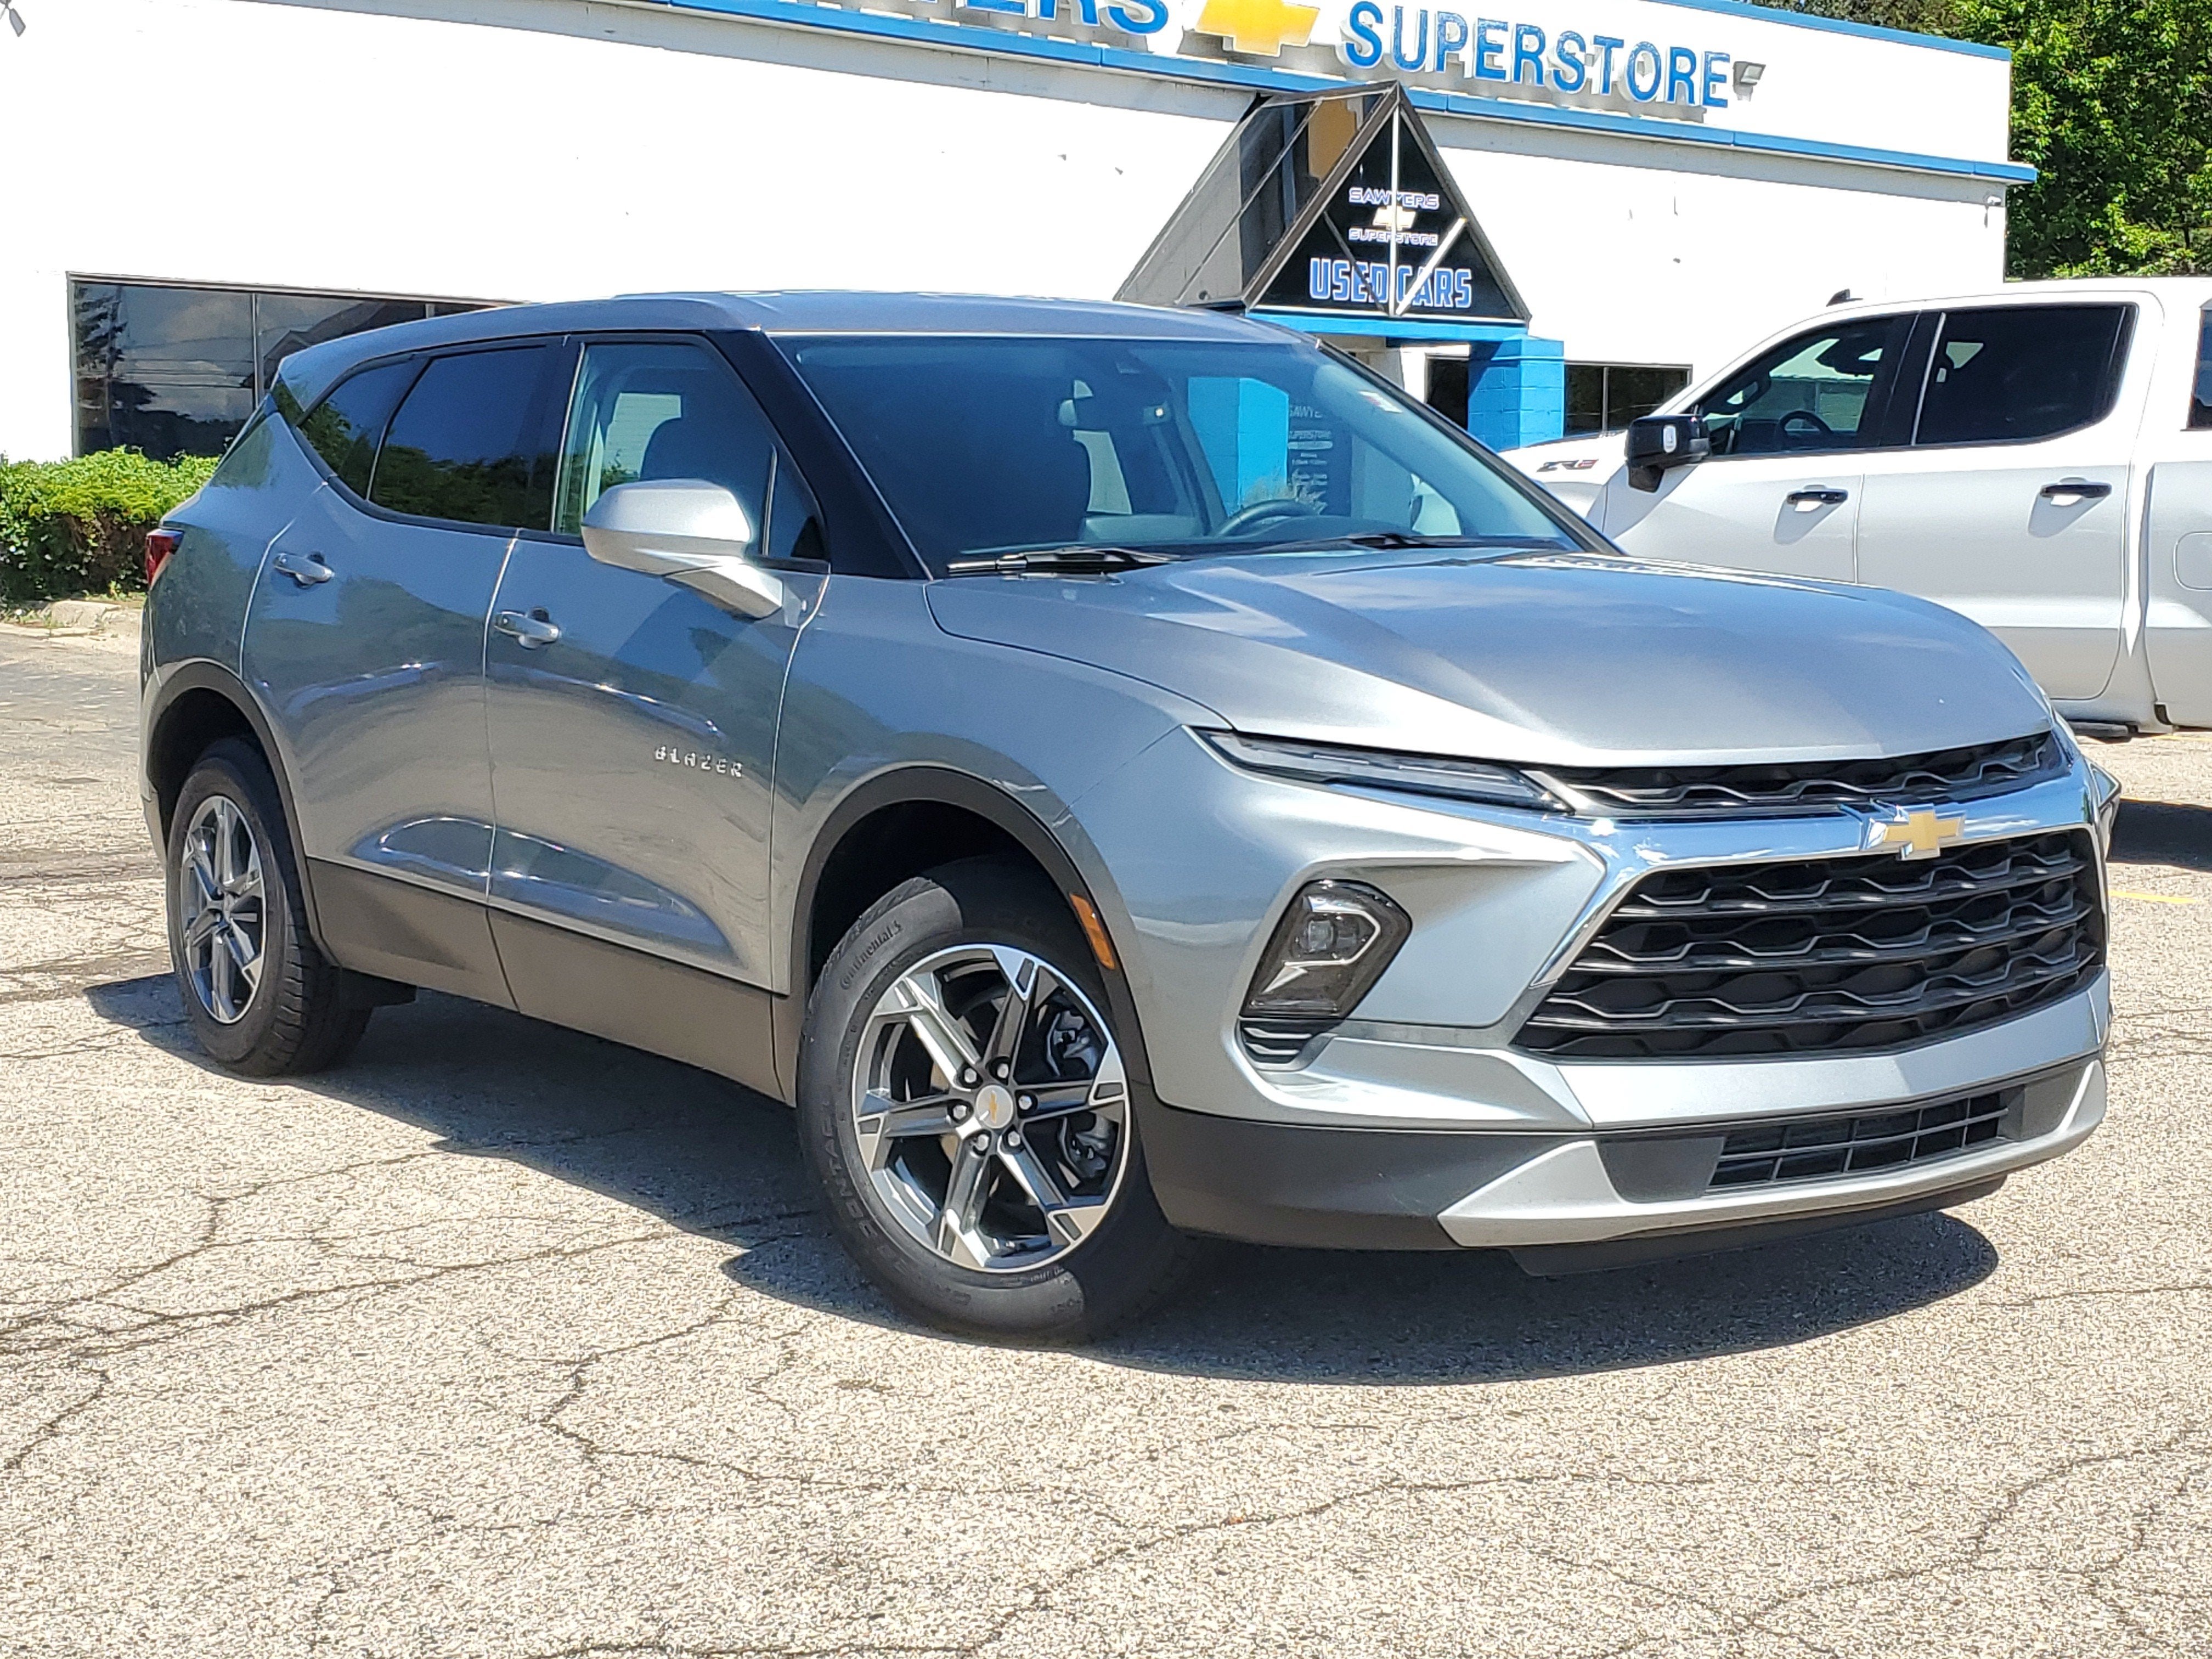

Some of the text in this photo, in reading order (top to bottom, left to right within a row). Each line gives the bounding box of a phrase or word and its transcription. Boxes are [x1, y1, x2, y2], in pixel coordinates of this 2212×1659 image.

[1342, 0, 1731, 108] SUPERSTORE
[1310, 257, 1472, 309] USED CARS
[654, 745, 743, 778] BLAZER
[839, 924, 895, 990] Continental
